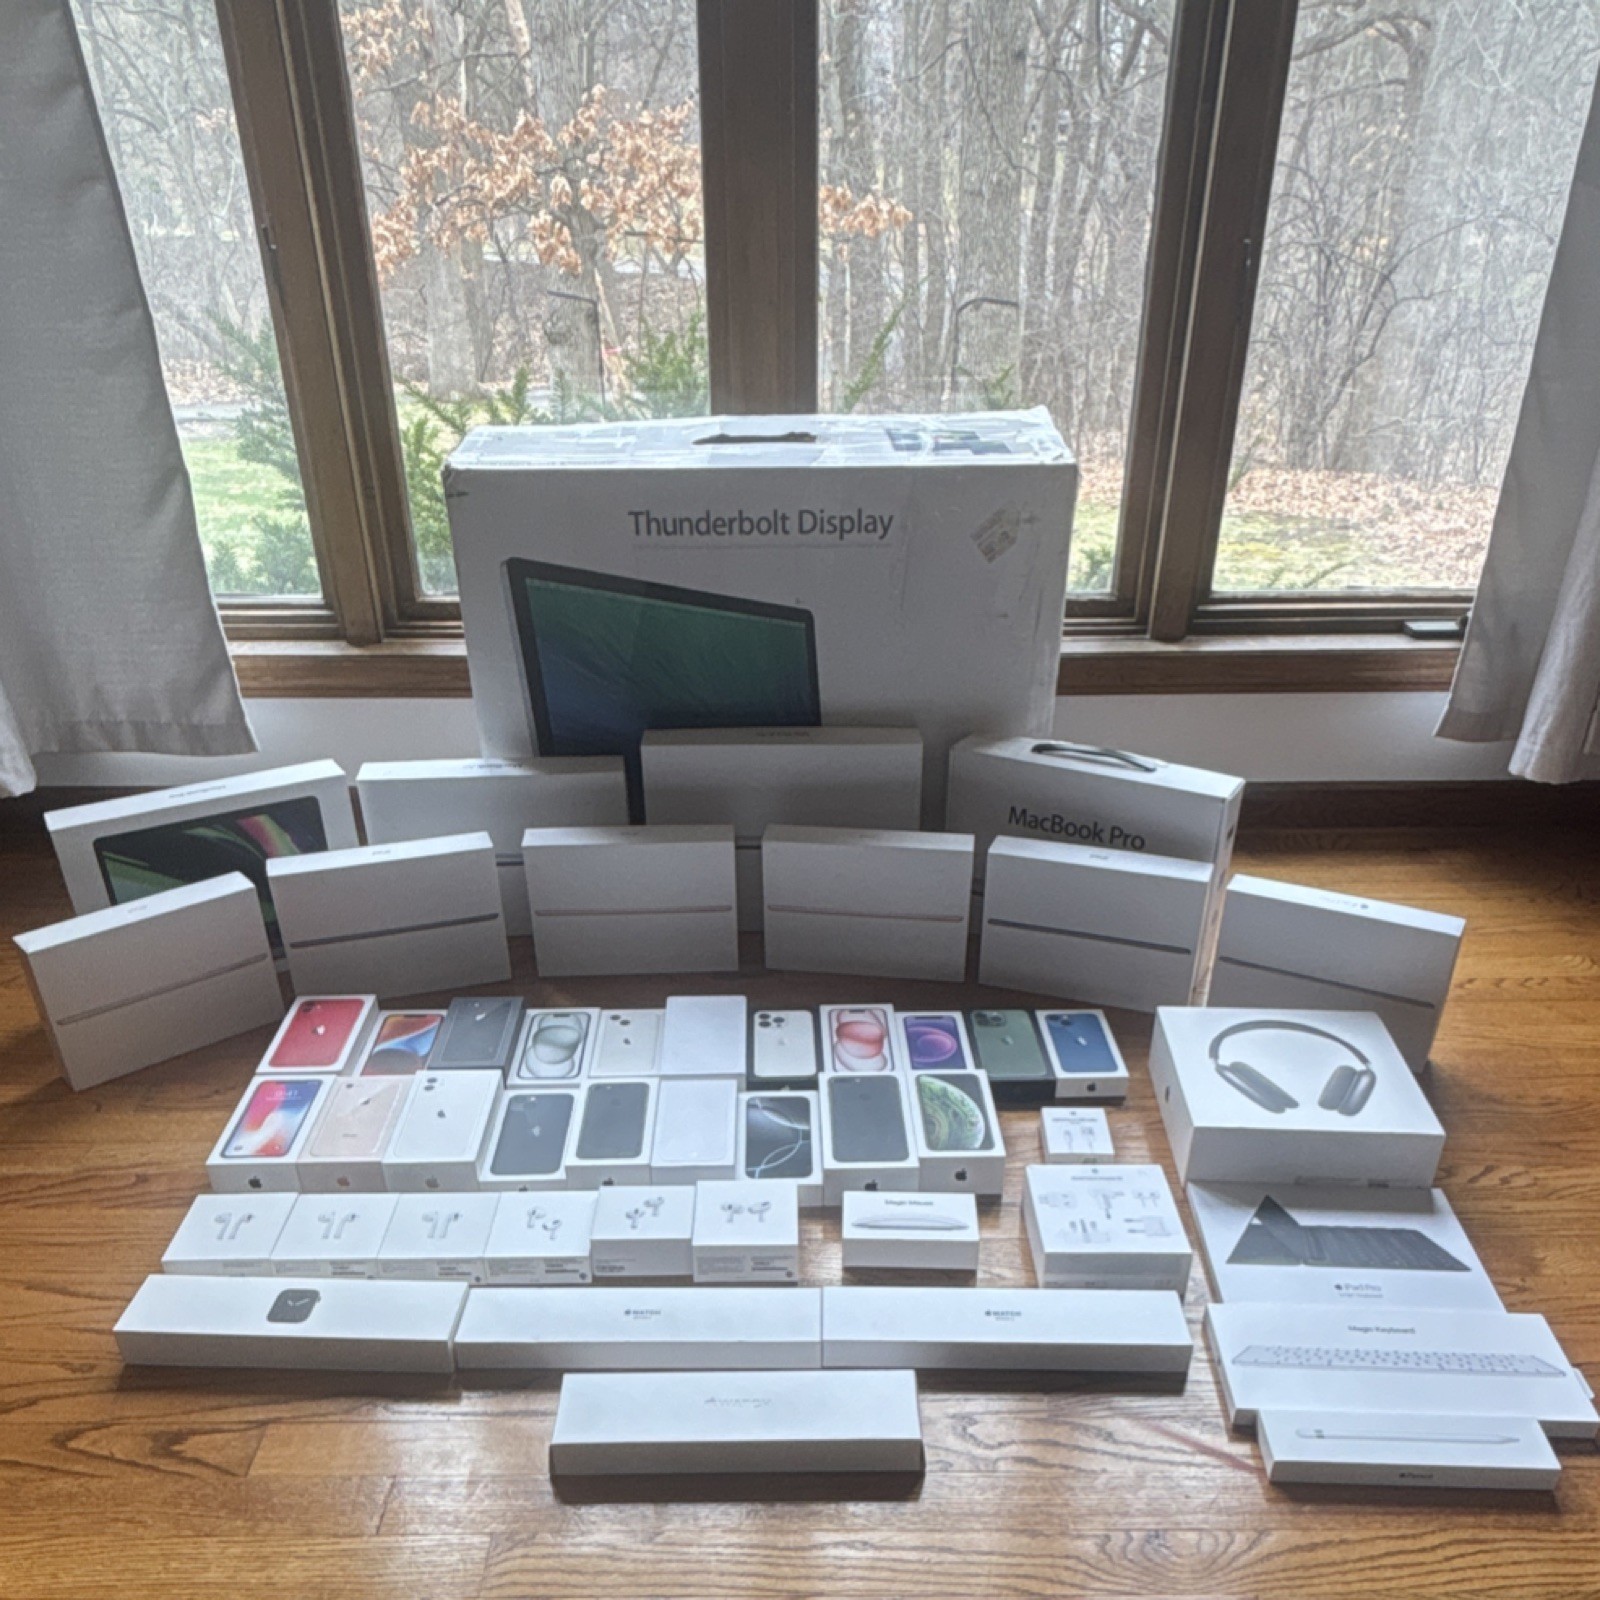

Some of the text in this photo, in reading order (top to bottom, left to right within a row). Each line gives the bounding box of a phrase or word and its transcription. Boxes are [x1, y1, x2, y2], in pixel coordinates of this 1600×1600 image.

[628, 507, 895, 541] Thunderbolt Display
[1008, 805, 1146, 851] MacBook Pro
